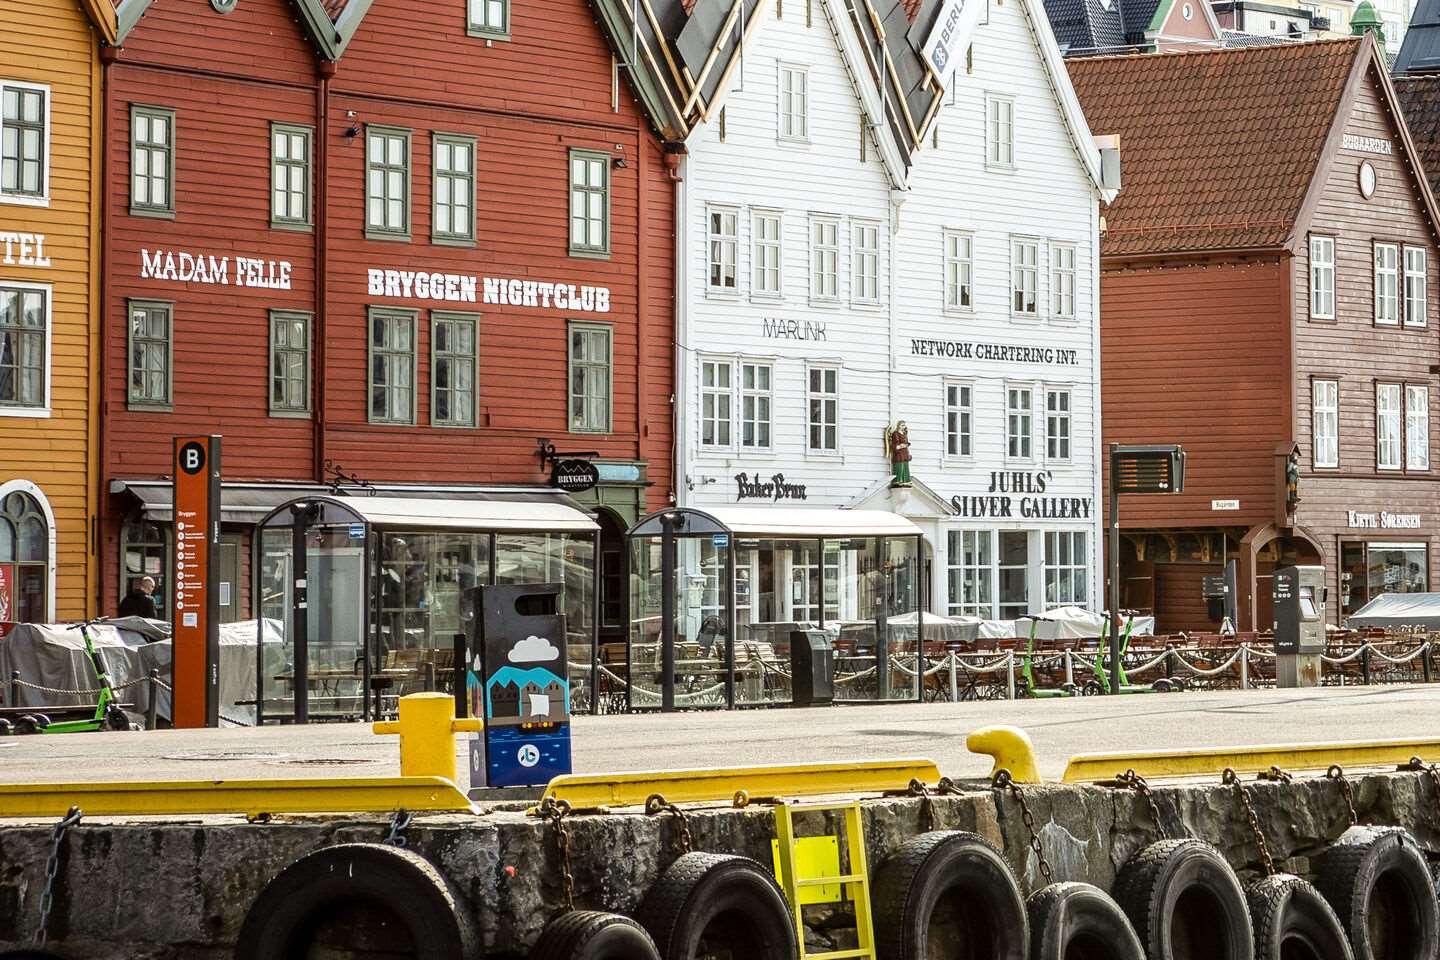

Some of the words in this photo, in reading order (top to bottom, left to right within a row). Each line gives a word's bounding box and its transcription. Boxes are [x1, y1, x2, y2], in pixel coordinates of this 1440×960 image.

[141, 248, 229, 285] MADAM
[235, 256, 292, 290] FELLE
[368, 268, 477, 303] BRYGGEN
[483, 277, 610, 312] NIGHTCLUB
[762, 317, 827, 342] MARLINK
[911, 339, 973, 359] NETWORK
[975, 343, 1053, 364] CHARTERING
[1056, 349, 1079, 366] INT.
[186, 449, 199, 469] B
[557, 474, 593, 484] BRYGGEN
[734, 472, 774, 502] Baker
[771, 473, 808, 503] Brun
[951, 495, 1012, 518] SILVER
[1019, 496, 1092, 519] GALLERY
